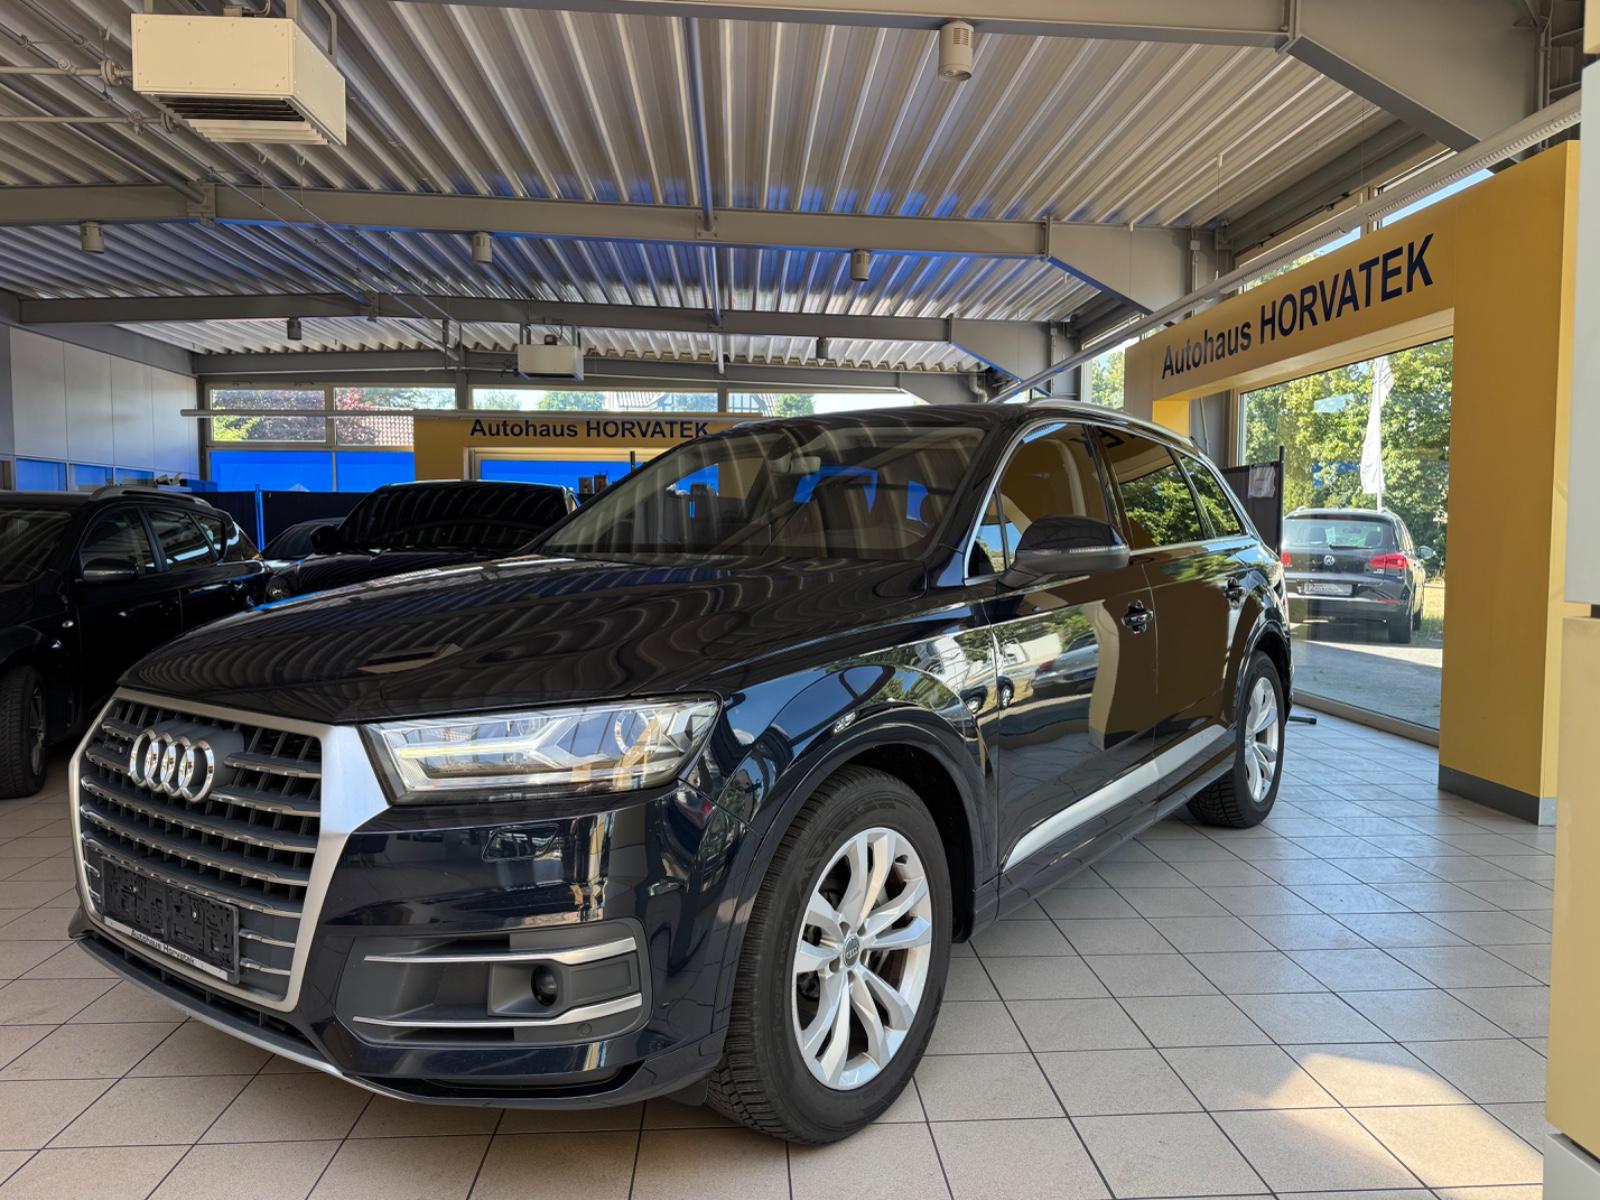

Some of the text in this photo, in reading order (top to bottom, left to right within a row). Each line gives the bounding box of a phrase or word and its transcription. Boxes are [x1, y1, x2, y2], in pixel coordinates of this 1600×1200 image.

[1162, 233, 1434, 379] Autohaus HORVATEK
[470, 418, 708, 438] Autohaus HORVATEK
